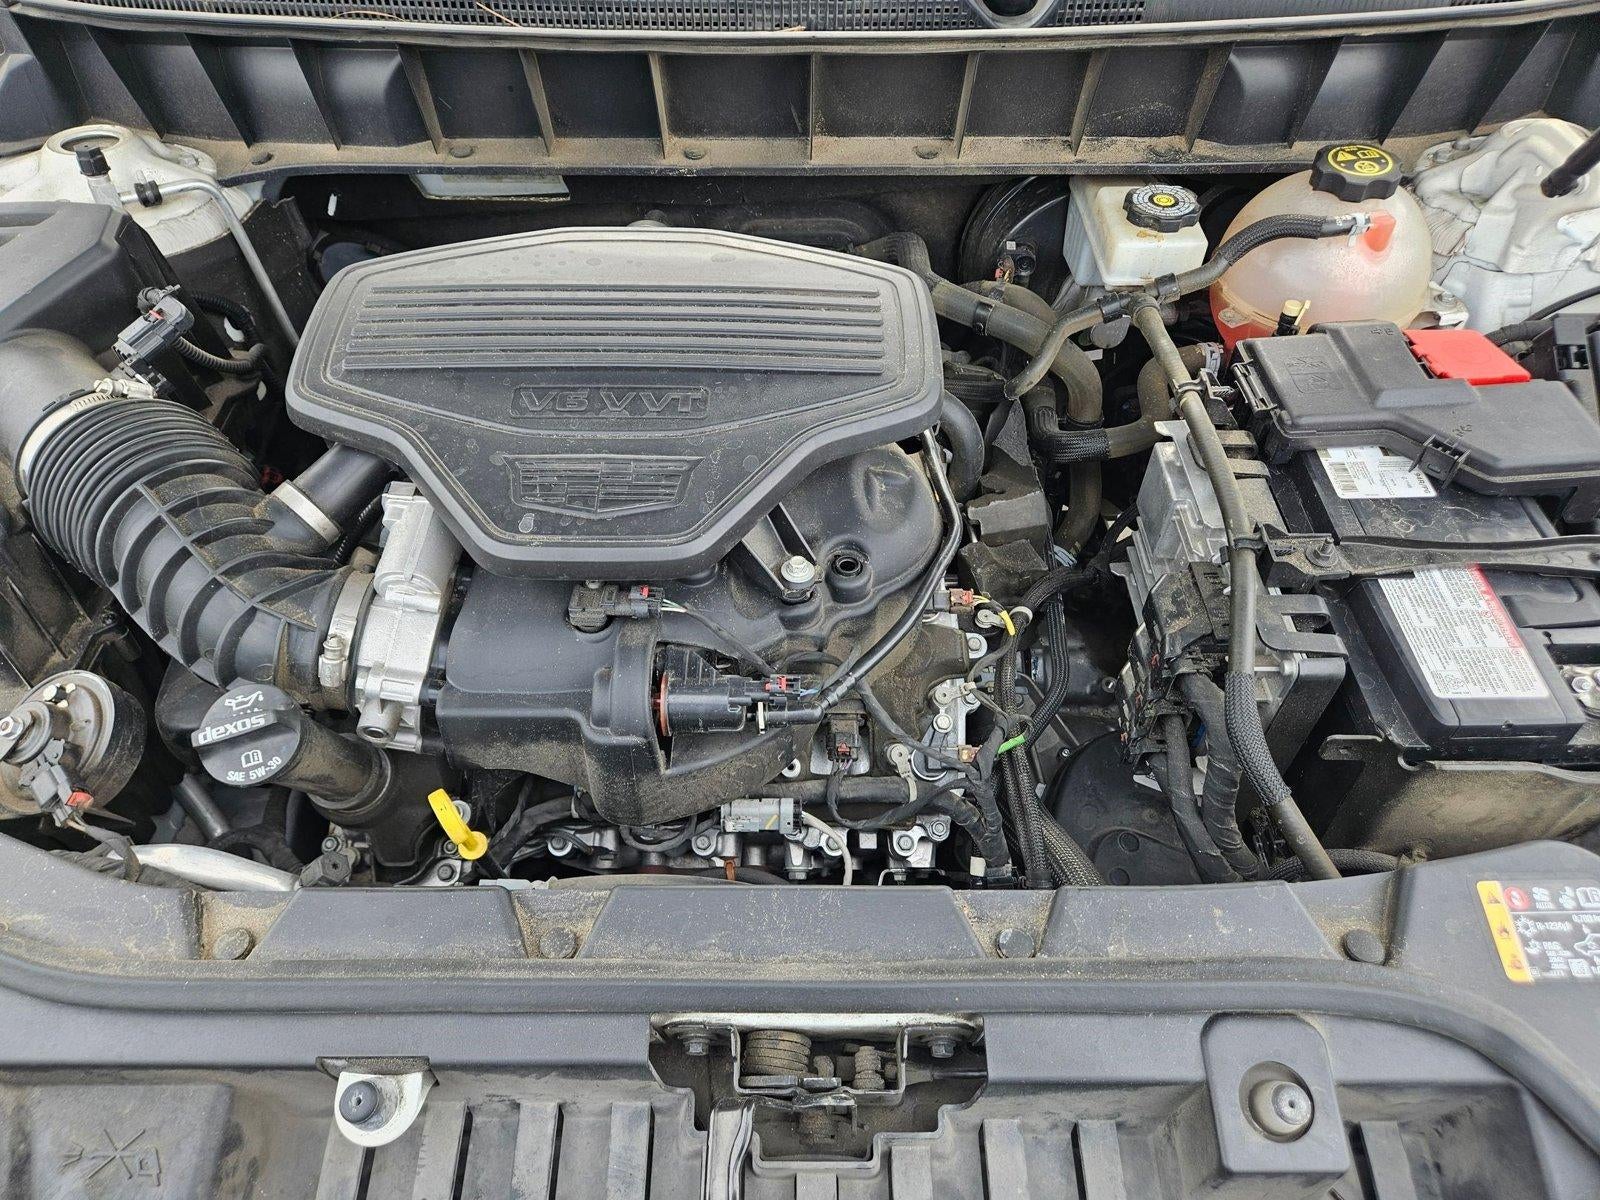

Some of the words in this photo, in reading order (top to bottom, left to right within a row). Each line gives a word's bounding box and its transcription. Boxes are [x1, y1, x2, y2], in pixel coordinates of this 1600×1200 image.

[519, 391, 590, 412] V6
[599, 391, 702, 413] VVT
[198, 713, 266, 745] dexos
[226, 770, 246, 781] SAE
[249, 756, 282, 780] 5W-30
